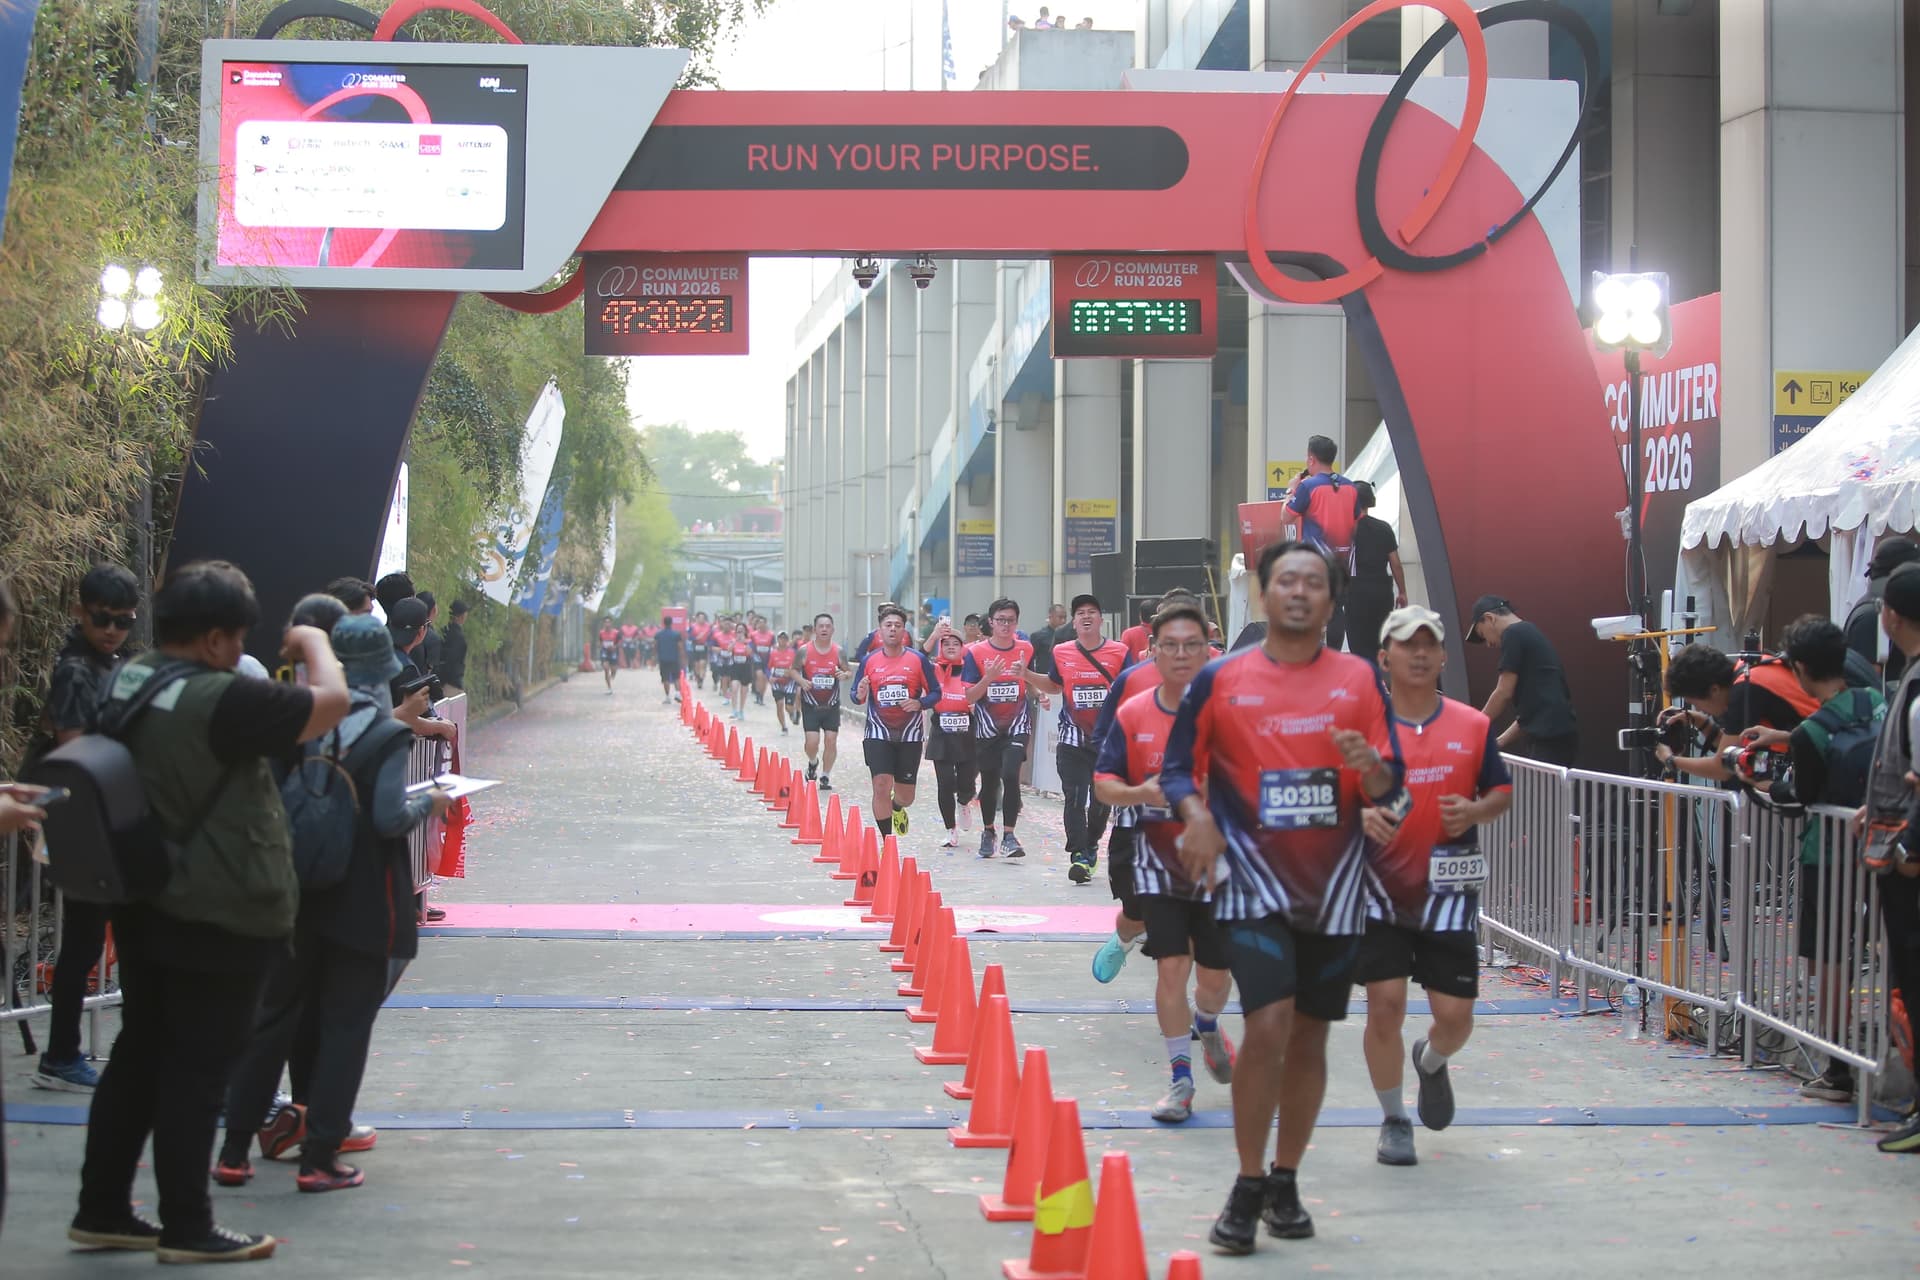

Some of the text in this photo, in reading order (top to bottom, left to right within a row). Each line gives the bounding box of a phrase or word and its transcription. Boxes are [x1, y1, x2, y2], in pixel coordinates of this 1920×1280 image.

[748, 143, 1099, 171] RUN YOUR PURPOSE.
[642, 267, 739, 281] COMMUTER
[1115, 262, 1198, 274] COMMUTER
[642, 281, 721, 295] RUN 2026
[1115, 275, 1182, 287] RUN 2026
[1645, 431, 1692, 493] 2026
[880, 690, 907, 699] 50490
[992, 687, 1016, 695] 51274
[1078, 691, 1102, 700] 51381
[1268, 784, 1334, 807] 50318
[1437, 859, 1483, 876] 50937
